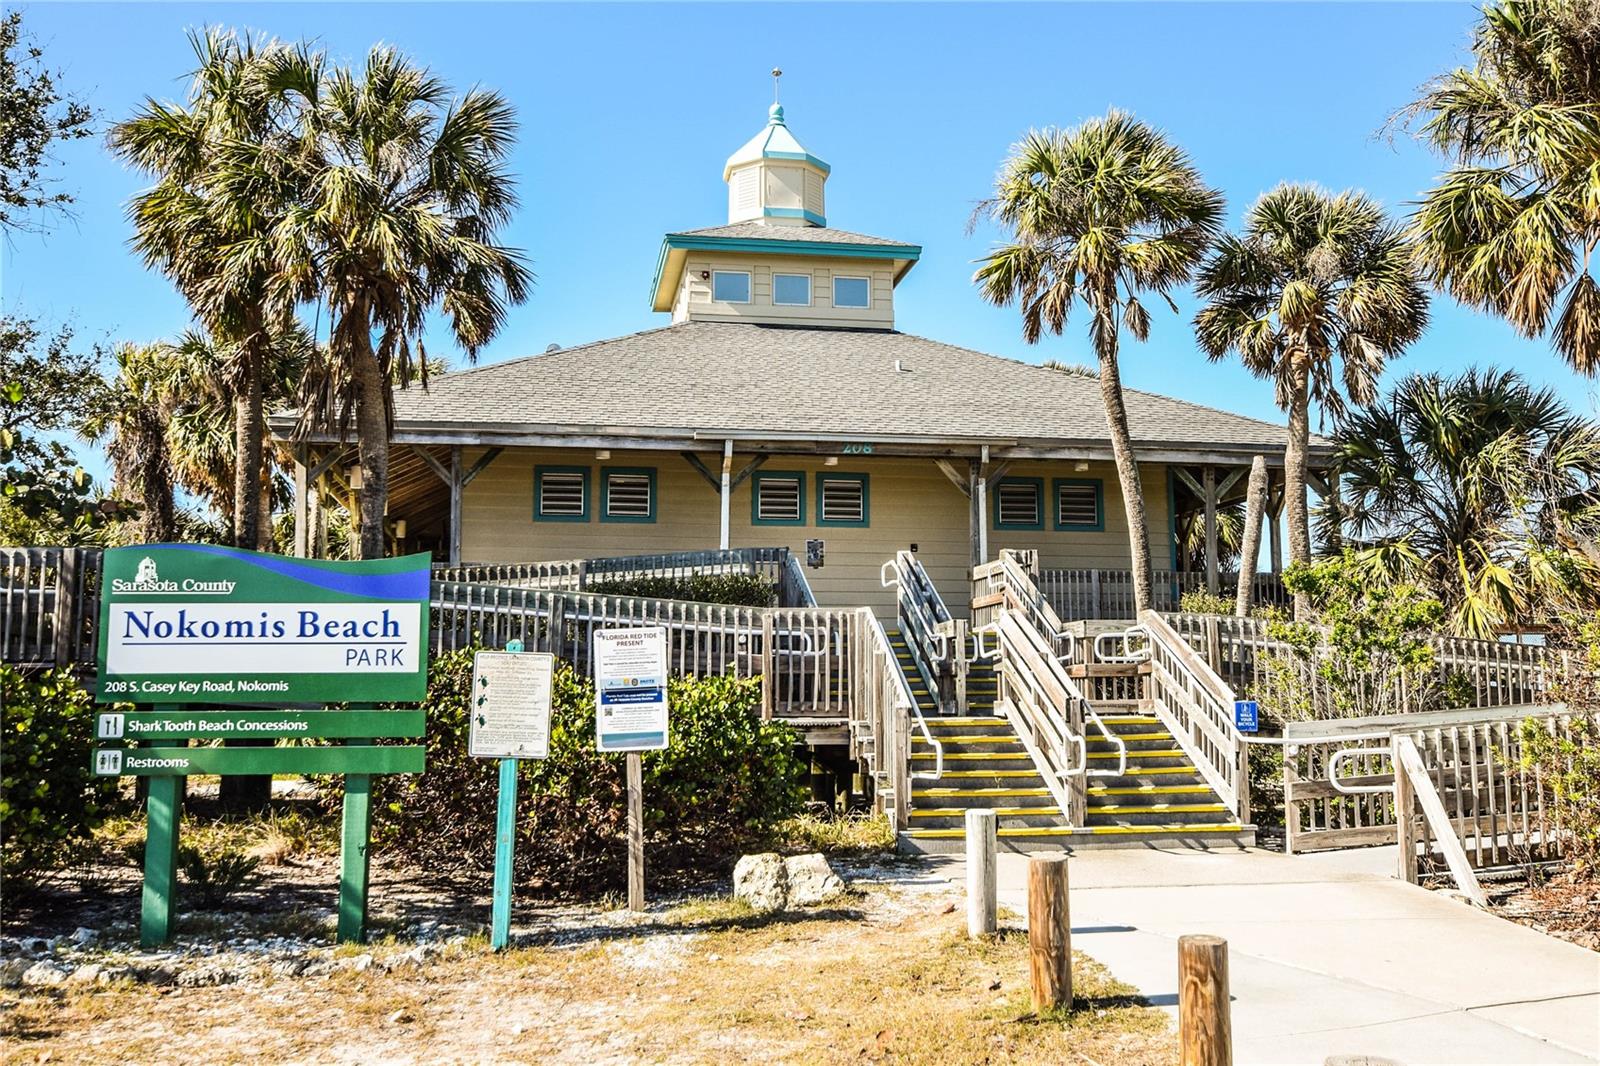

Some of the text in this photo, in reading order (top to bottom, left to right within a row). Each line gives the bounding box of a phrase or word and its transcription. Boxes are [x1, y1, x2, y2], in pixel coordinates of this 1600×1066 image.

[112, 579, 237, 595] Sarasota County
[122, 609, 401, 638] Nokomis Beach
[345, 648, 404, 666] PARK
[104, 680, 289, 694] 208 S. Casey Key Road, Nokomis
[128, 719, 308, 732] Shark Tooth Beach Concessions
[126, 757, 189, 769] Restrooms
